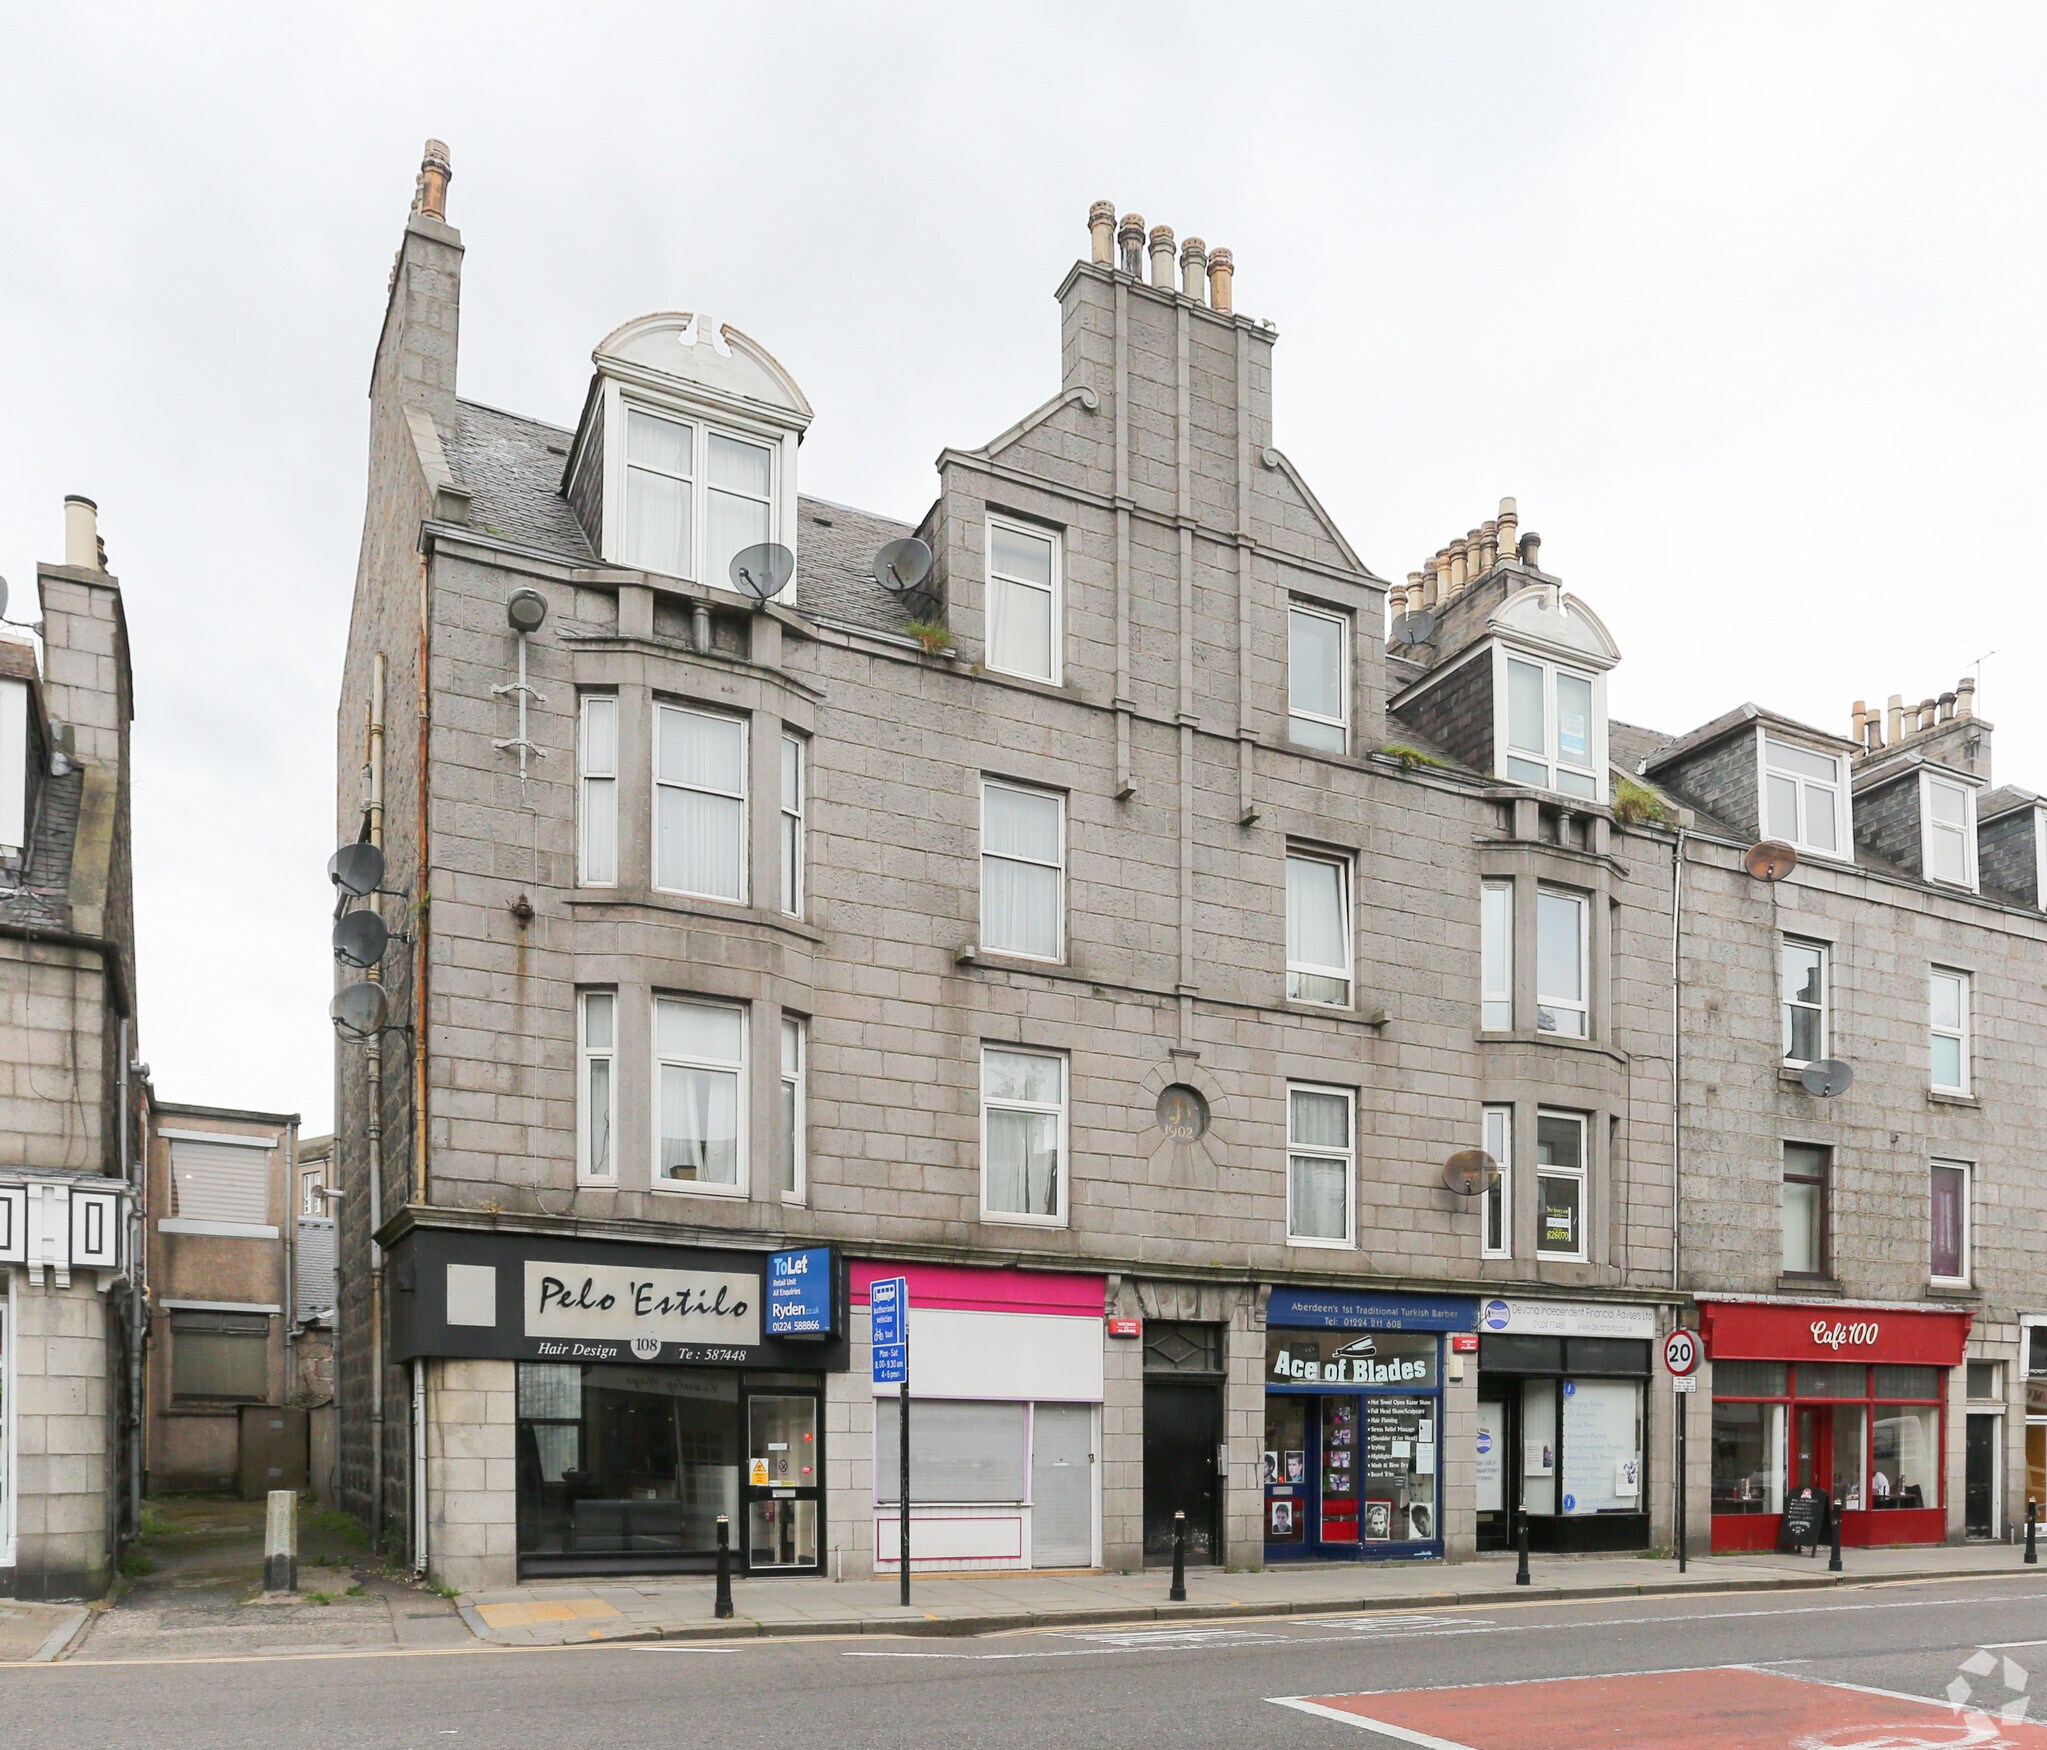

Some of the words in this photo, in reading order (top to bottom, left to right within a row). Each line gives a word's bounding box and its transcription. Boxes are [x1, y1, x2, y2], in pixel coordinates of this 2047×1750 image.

[1165, 1124, 1193, 1139] 1902
[1547, 1230, 1569, 1240] 626070
[773, 1279, 786, 1287] Retail
[539, 1276, 616, 1314] Pelo
[630, 1281, 748, 1317] 'Estilo
[780, 1288, 801, 1296] Enquiries
[1291, 1303, 1338, 1313] Aberdeen's
[1342, 1306, 1353, 1314] 1st
[1356, 1306, 1399, 1316] Traditional
[1401, 1308, 1430, 1317] Turkish
[1432, 1310, 1458, 1318] Barber
[1512, 1304, 1539, 1316] Devana
[1541, 1305, 1584, 1318] Independent
[1586, 1308, 1614, 1318] Financial
[1616, 1309, 1642, 1320] Advisers
[1642, 1312, 1652, 1320] Ltd
[772, 1322, 792, 1332] 01224
[794, 1320, 820, 1331] 588866
[876, 1315, 893, 1324] vehicles
[1324, 1317, 1338, 1326] Tel:
[1344, 1318, 1368, 1327] 01224
[1370, 1319, 1383, 1328] 211
[1386, 1320, 1402, 1329] 608
[1533, 1320, 1548, 1329] 01224
[885, 1330, 894, 1338] taxi
[1810, 1320, 1847, 1351] Café
[1848, 1322, 1879, 1345] 100
[538, 1342, 569, 1355] Hair
[572, 1343, 618, 1359] Design
[637, 1338, 658, 1352] 108
[704, 1349, 747, 1362] 587448
[1669, 1344, 1690, 1362] 20
[1273, 1350, 1318, 1380] Ace
[1324, 1358, 1347, 1382] of
[1352, 1358, 1427, 1383] Blades
